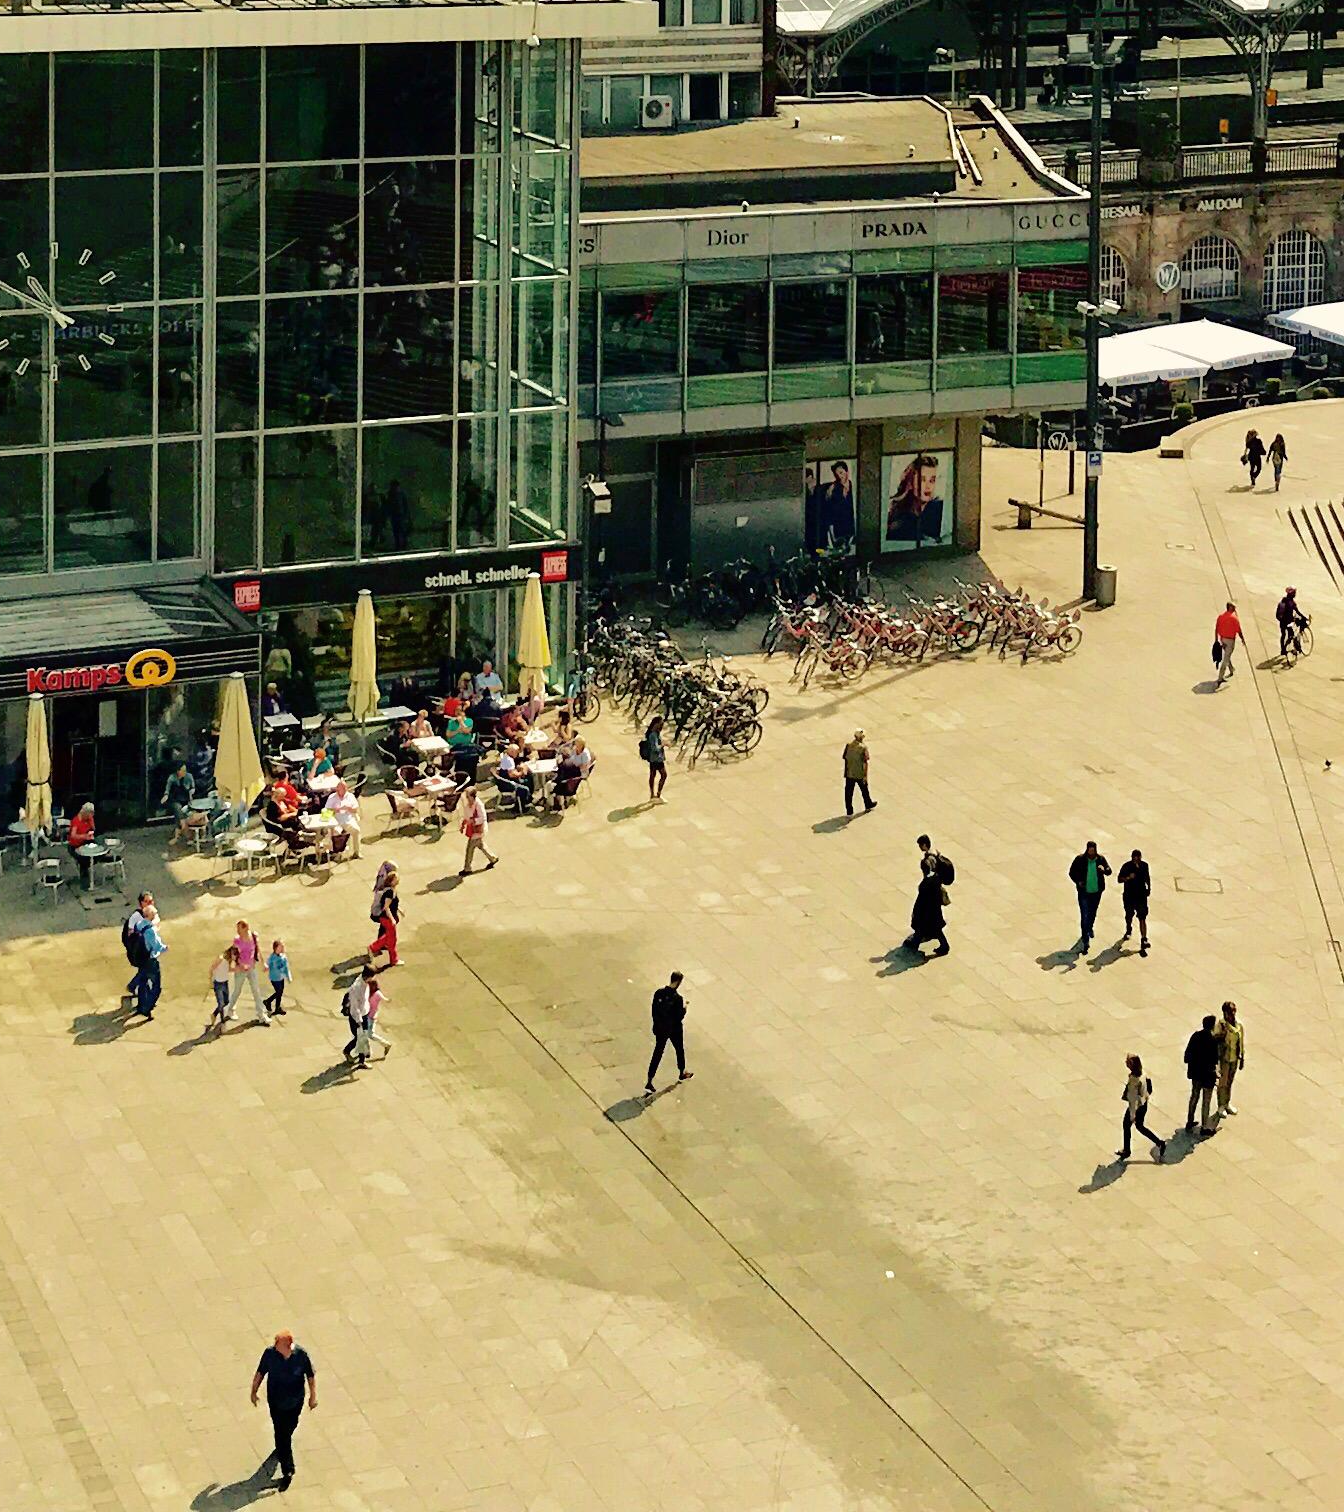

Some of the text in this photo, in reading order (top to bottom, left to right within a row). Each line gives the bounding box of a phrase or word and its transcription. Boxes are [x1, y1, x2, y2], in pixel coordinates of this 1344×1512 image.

[1197, 199, 1217, 212] AM
[1218, 197, 1244, 210] DOM
[707, 230, 750, 247] Dior
[862, 222, 928, 239] PRADA
[31, 320, 143, 344] SARBUCKS
[425, 569, 473, 589] schnell.
[27, 663, 123, 693] Kamps
